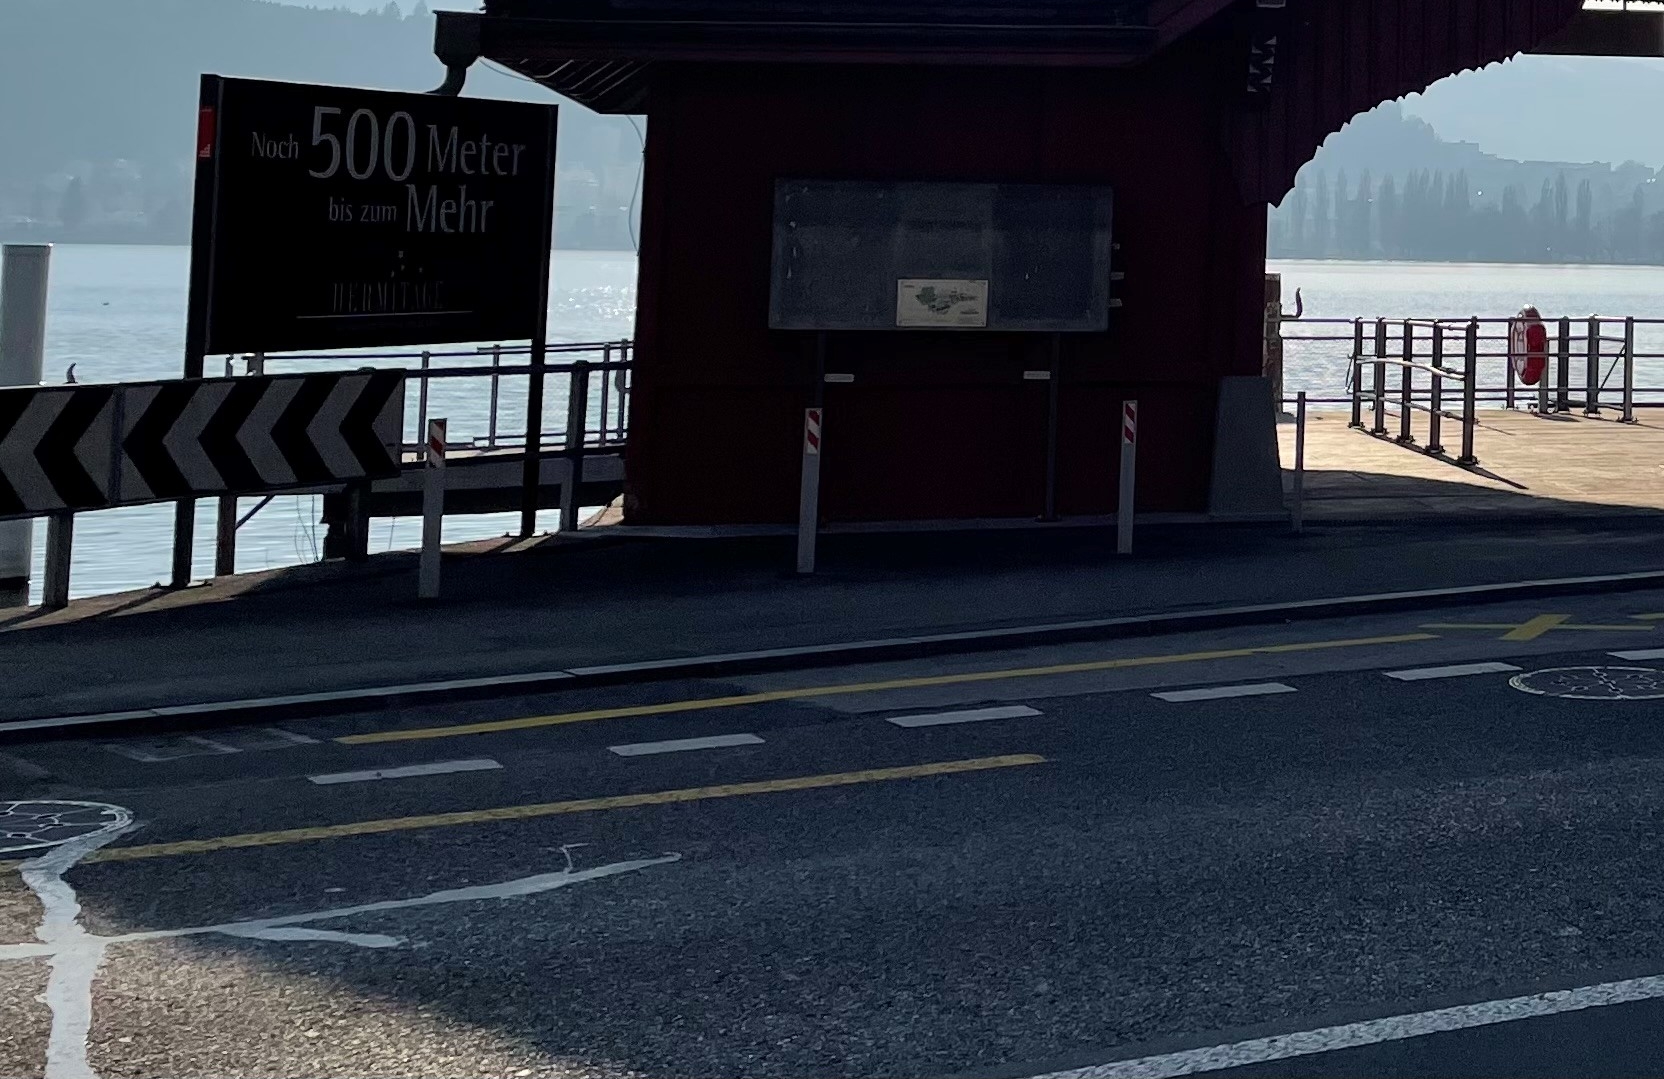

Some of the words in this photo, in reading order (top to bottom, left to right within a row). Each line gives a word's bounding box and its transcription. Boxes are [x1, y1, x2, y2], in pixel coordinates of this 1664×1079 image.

[250, 131, 299, 160] Noch
[308, 105, 416, 182] 500
[426, 123, 527, 177] Meter
[328, 195, 353, 223] bis
[359, 202, 398, 223] zum
[404, 183, 495, 234] Mehr
